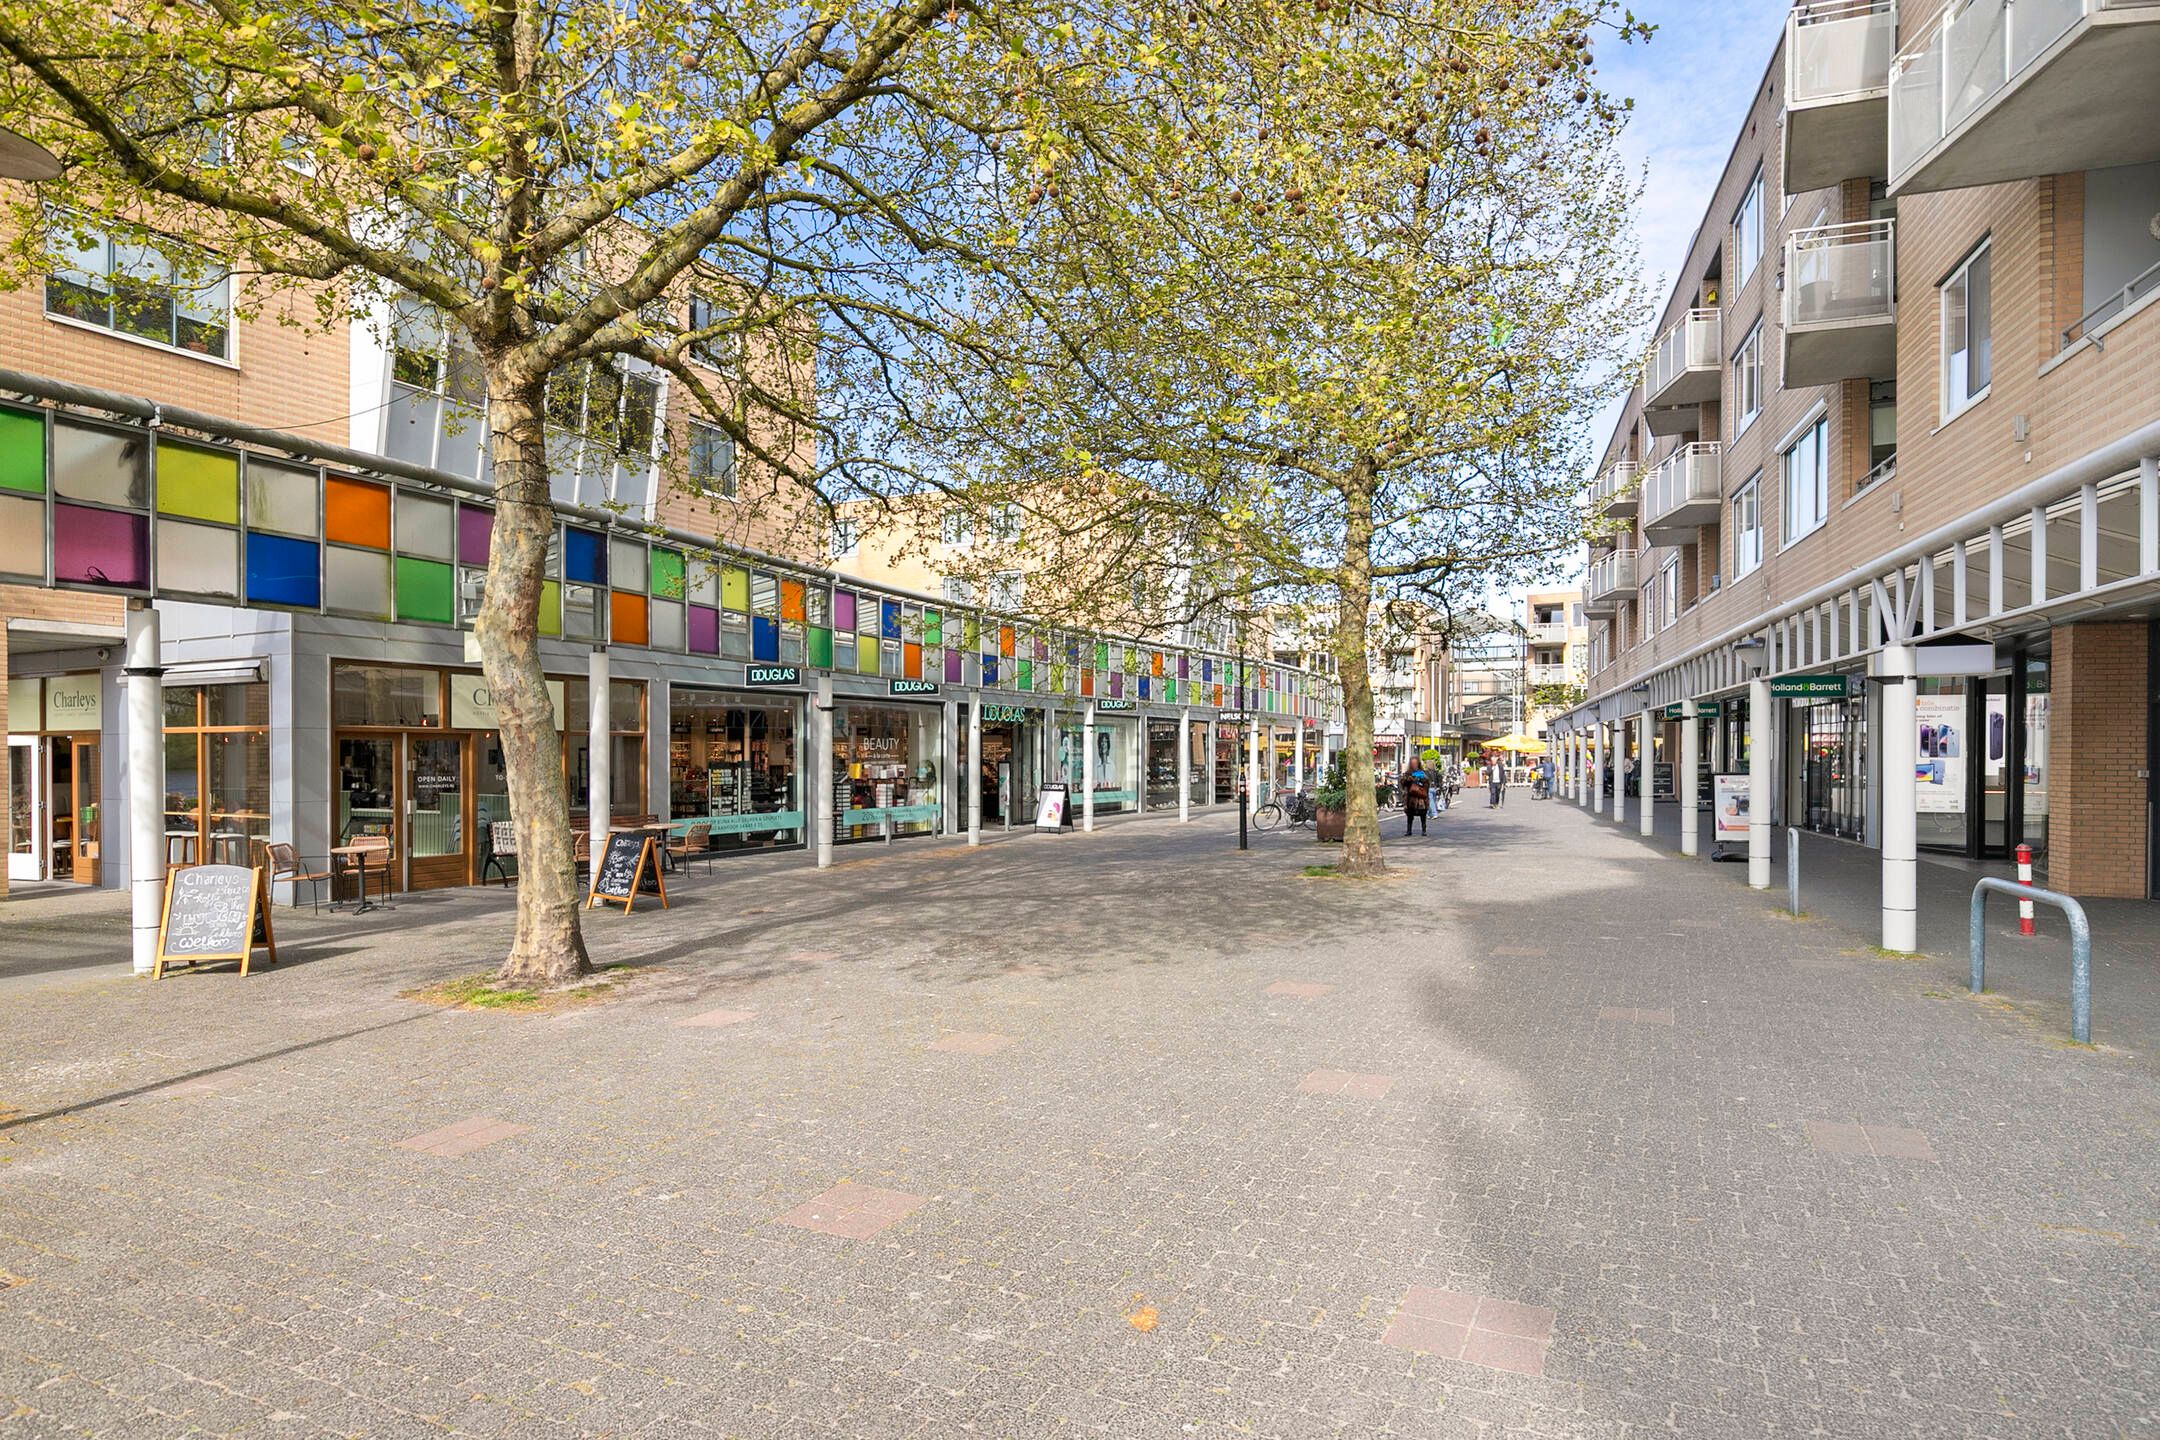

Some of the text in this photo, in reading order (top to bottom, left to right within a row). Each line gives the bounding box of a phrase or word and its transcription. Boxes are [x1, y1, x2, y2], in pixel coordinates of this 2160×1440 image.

[751, 668, 796, 682] DOUGLAS
[894, 681, 935, 692] DOUGLAS
[1809, 682, 1842, 691] Barrett
[53, 690, 97, 712] Charleys
[984, 705, 1026, 722] DOUGLAS
[863, 737, 900, 751] BEAUTY
[417, 775, 457, 783] OPEN DAILY
[183, 873, 240, 886] Charleys
